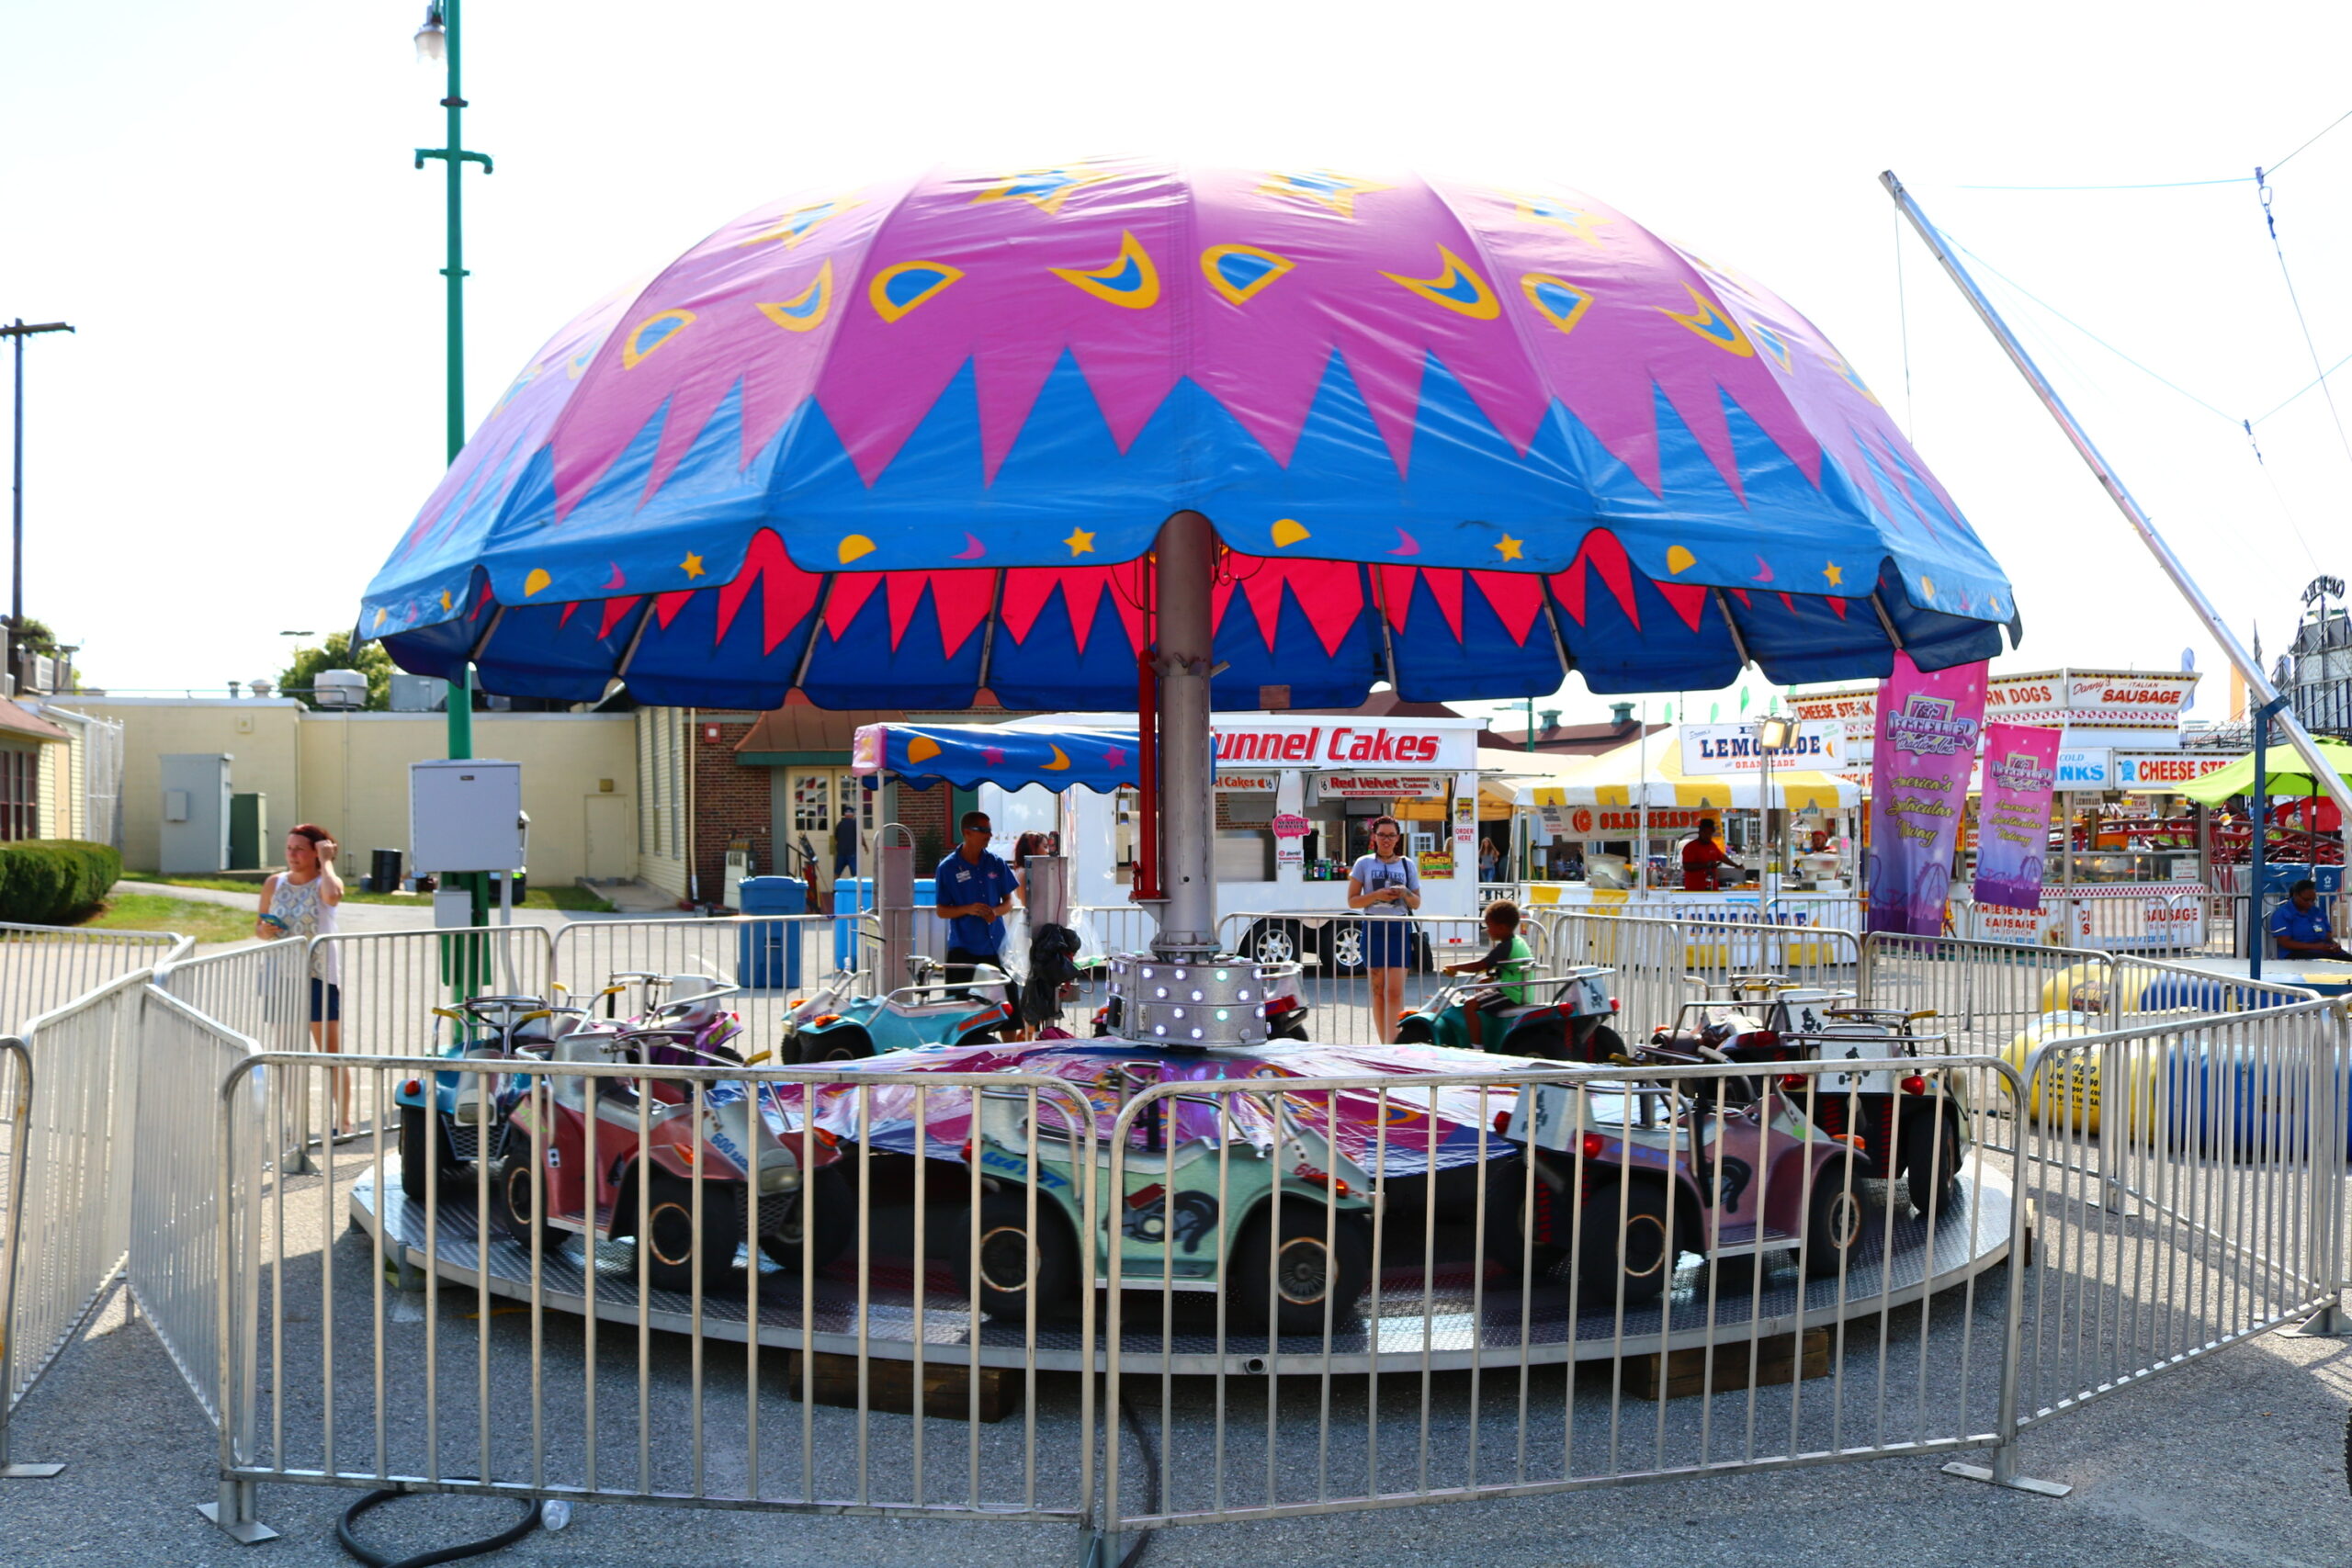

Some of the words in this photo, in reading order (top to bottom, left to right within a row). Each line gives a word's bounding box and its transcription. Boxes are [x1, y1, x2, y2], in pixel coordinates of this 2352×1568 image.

[2073, 677, 2111, 696] Danny's
[2129, 681, 2159, 689] ITALIAN
[1986, 689, 2006, 706] RN
[2010, 685, 2052, 705] DOGS
[2100, 689, 2182, 705] SAUSAGE
[1797, 703, 1836, 721] CHEESE
[1211, 727, 1321, 761] unnel
[1327, 727, 1440, 762] Cakes
[1735, 759, 1796, 770] ORANEADE
[2059, 753, 2085, 761] COLD
[2055, 764, 2105, 782] NKS
[2139, 760, 2196, 781] CHEESE
[2199, 760, 2235, 780] STE
[1225, 776, 1256, 788] Cakes
[1329, 776, 1356, 789] Red
[1357, 776, 1400, 789] Velvet
[2016, 907, 2050, 918] SEA
[1991, 928, 2032, 936] SADWICH
[711, 1133, 736, 1155] 600
